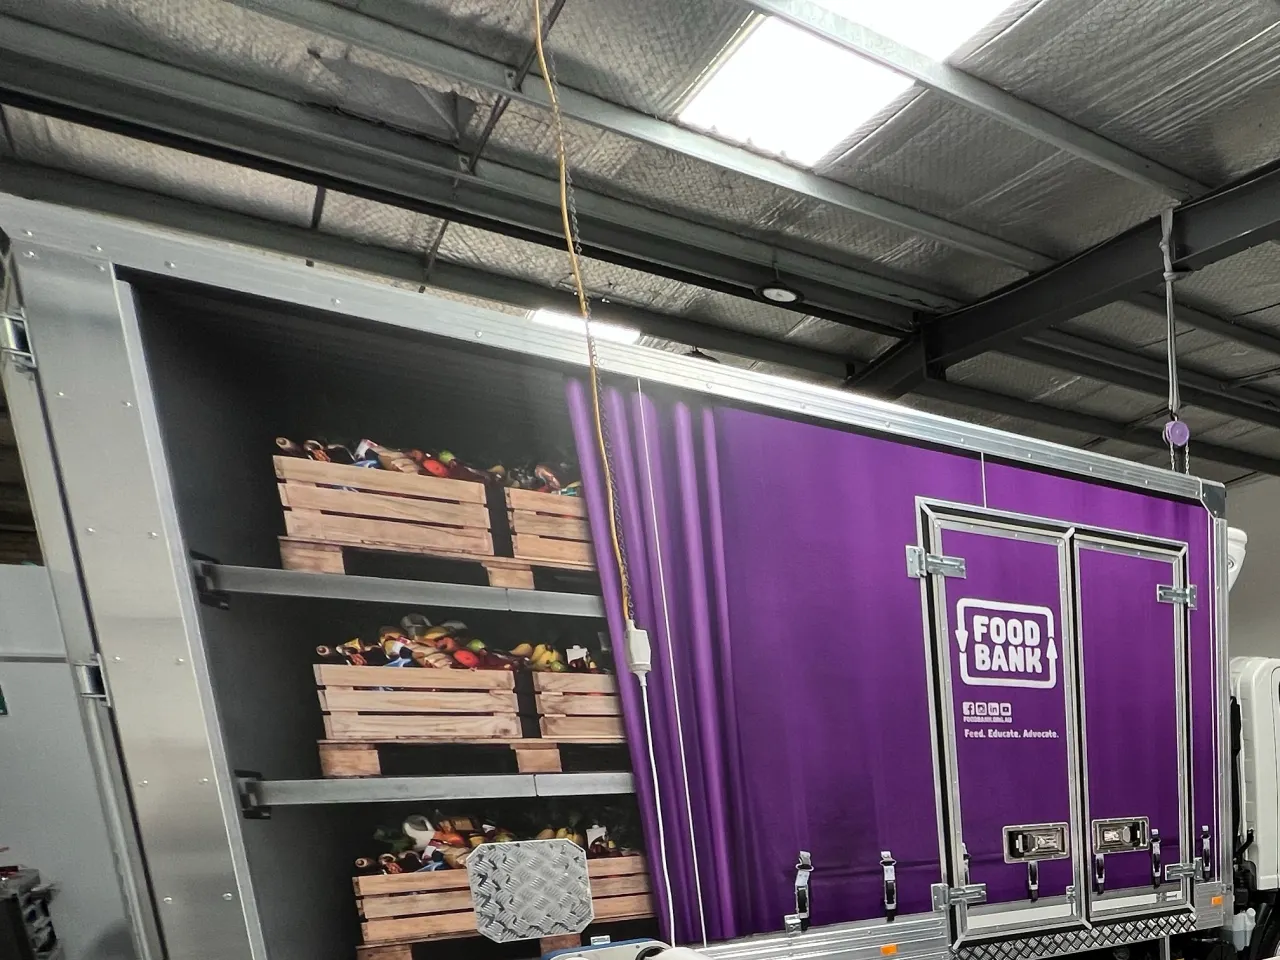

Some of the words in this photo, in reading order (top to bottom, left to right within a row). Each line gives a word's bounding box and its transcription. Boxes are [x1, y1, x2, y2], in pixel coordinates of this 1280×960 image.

[973, 615, 1041, 646] FOOD
[974, 644, 1043, 674] BANK
[964, 728, 986, 738] Feed.
[988, 729, 1021, 738] Educate.
[1023, 729, 1060, 738] Advocate.
